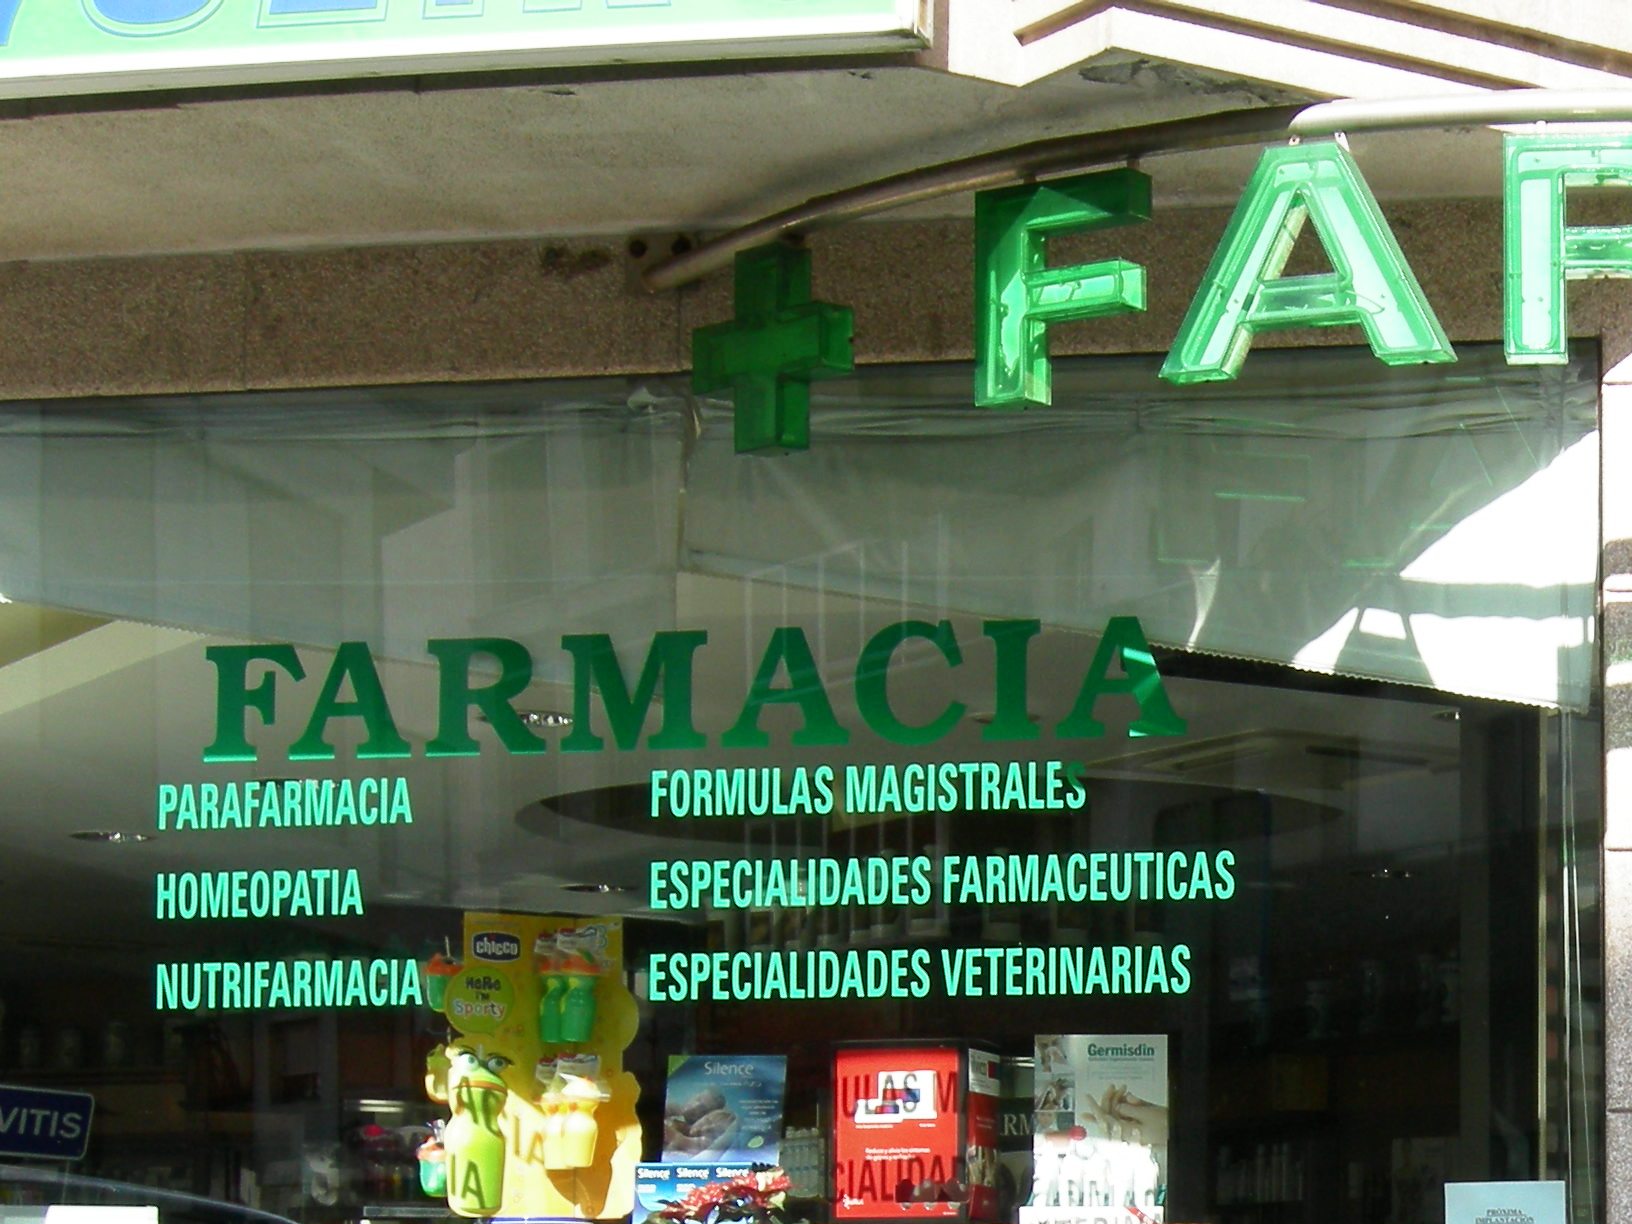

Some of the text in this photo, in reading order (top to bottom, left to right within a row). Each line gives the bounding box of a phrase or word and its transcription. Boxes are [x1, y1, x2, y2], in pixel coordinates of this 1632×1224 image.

[203, 614, 1190, 763] FARMACIA
[158, 776, 413, 830] PARAFARMACIA
[650, 760, 1087, 818] FORMULAS MAGISTRALES
[156, 868, 364, 919] HOMEOPATIA
[650, 850, 1237, 910] ESPECIALIDADES FARMACEUTICAS
[156, 958, 424, 1010] NUTRIFARMACIA
[649, 944, 1192, 1002] ESPECIALIDADES VETERINARIAS
[703, 1061, 755, 1077] Silence
[1087, 1043, 1155, 1058] Germisdin
